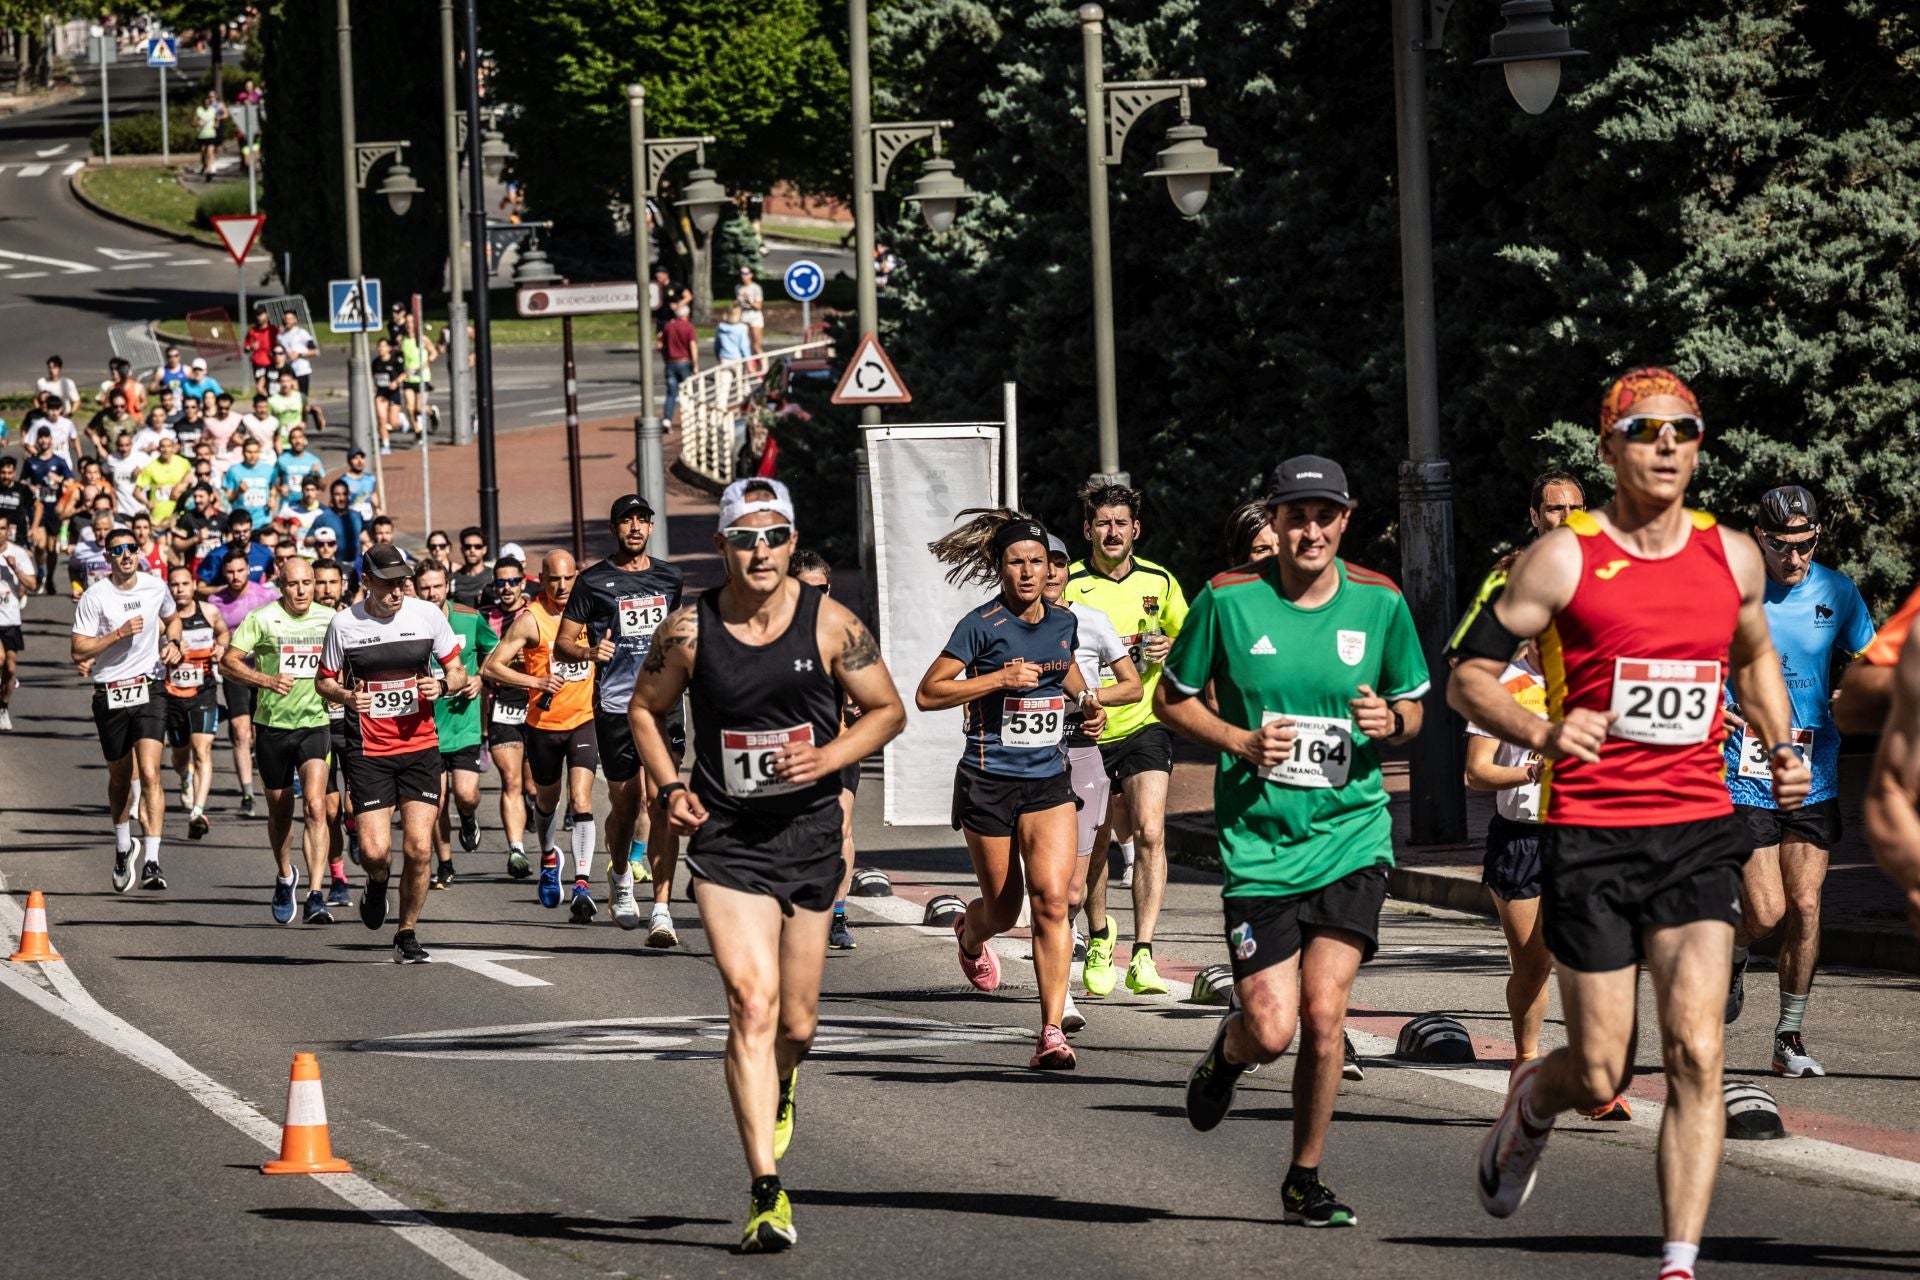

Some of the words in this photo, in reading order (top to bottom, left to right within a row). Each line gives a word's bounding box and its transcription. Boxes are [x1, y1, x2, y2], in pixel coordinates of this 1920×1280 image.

[626, 607, 663, 626] 313
[285, 654, 319, 668] 470
[173, 671, 198, 681] 491
[112, 685, 142, 701] 377
[375, 690, 413, 708] 399
[1624, 685, 1706, 720] 203
[1010, 712, 1057, 734] 539
[1650, 721, 1684, 730] ANGEL
[1291, 738, 1347, 765] 164
[734, 751, 777, 779] 16
[1287, 766, 1323, 775] IMANOL
